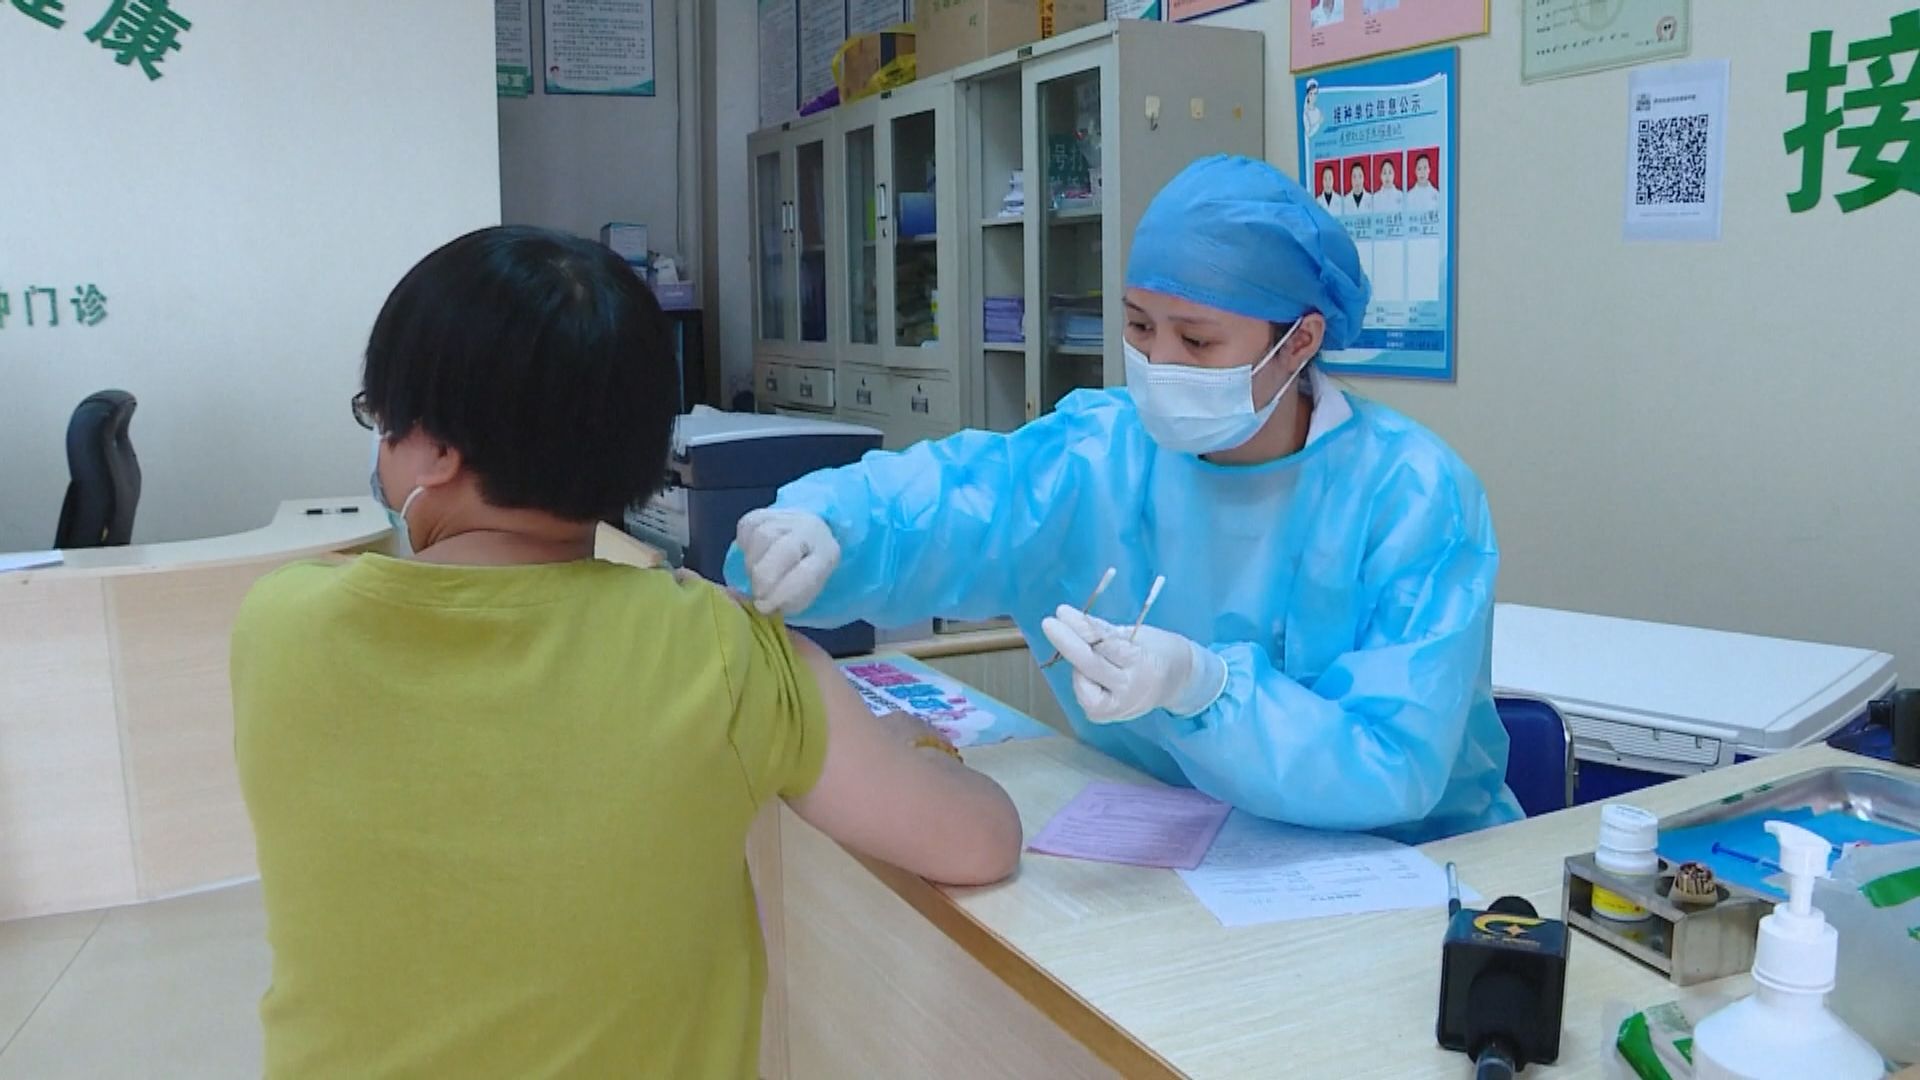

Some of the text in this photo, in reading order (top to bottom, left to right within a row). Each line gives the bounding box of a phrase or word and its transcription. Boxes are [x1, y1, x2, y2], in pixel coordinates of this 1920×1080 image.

[1333, 94, 1421, 123] 接种单位信息公示
[1783, 8, 1920, 214] 接
